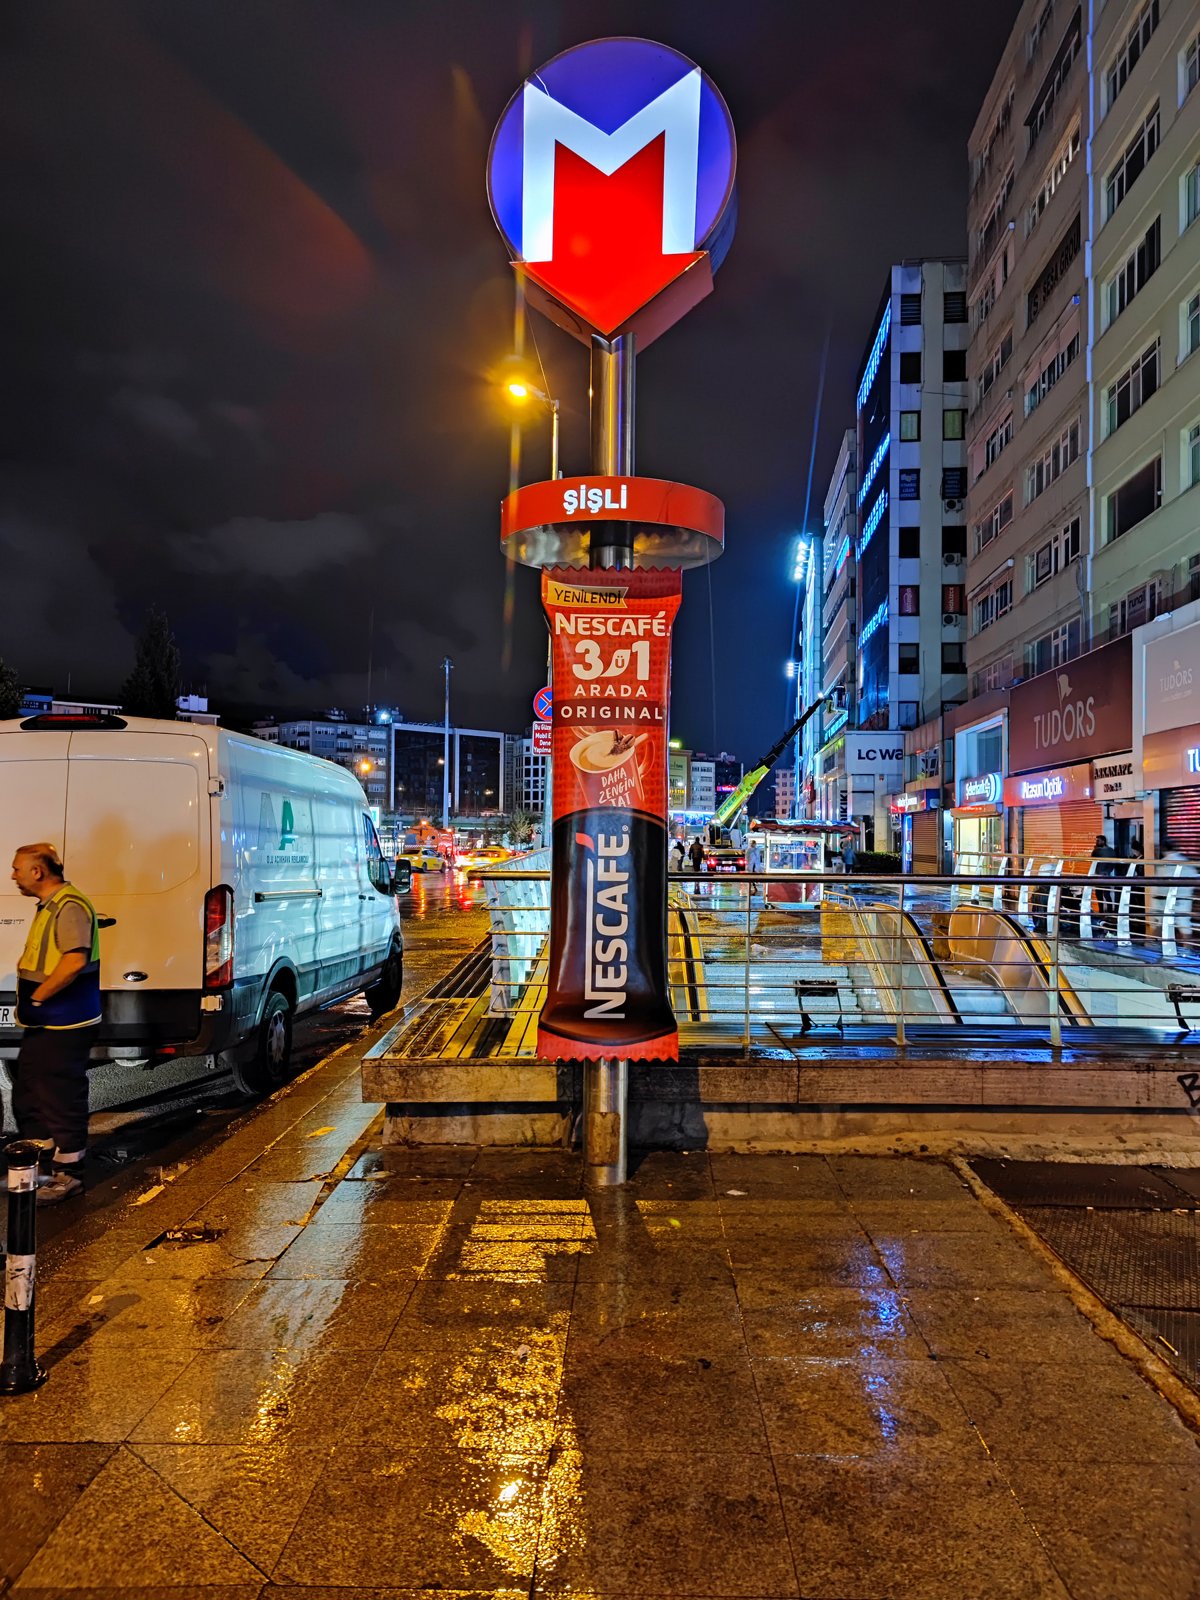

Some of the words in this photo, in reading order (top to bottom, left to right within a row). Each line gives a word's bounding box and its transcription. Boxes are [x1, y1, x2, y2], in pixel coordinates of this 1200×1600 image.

[522, 66, 702, 263] M
[563, 484, 627, 515] ŞİŞLİ
[555, 588, 621, 604] YENİLENDİ
[574, 684, 647, 697] ARADA
[1160, 668, 1192, 692] TUDORS
[561, 706, 662, 719] ORIGINAL
[1034, 696, 1095, 749] TUDORS
[858, 749, 877, 760] LC
[601, 767, 627, 788] DAHA
[1044, 776, 1062, 799] Optik
[609, 792, 630, 808] TAT
